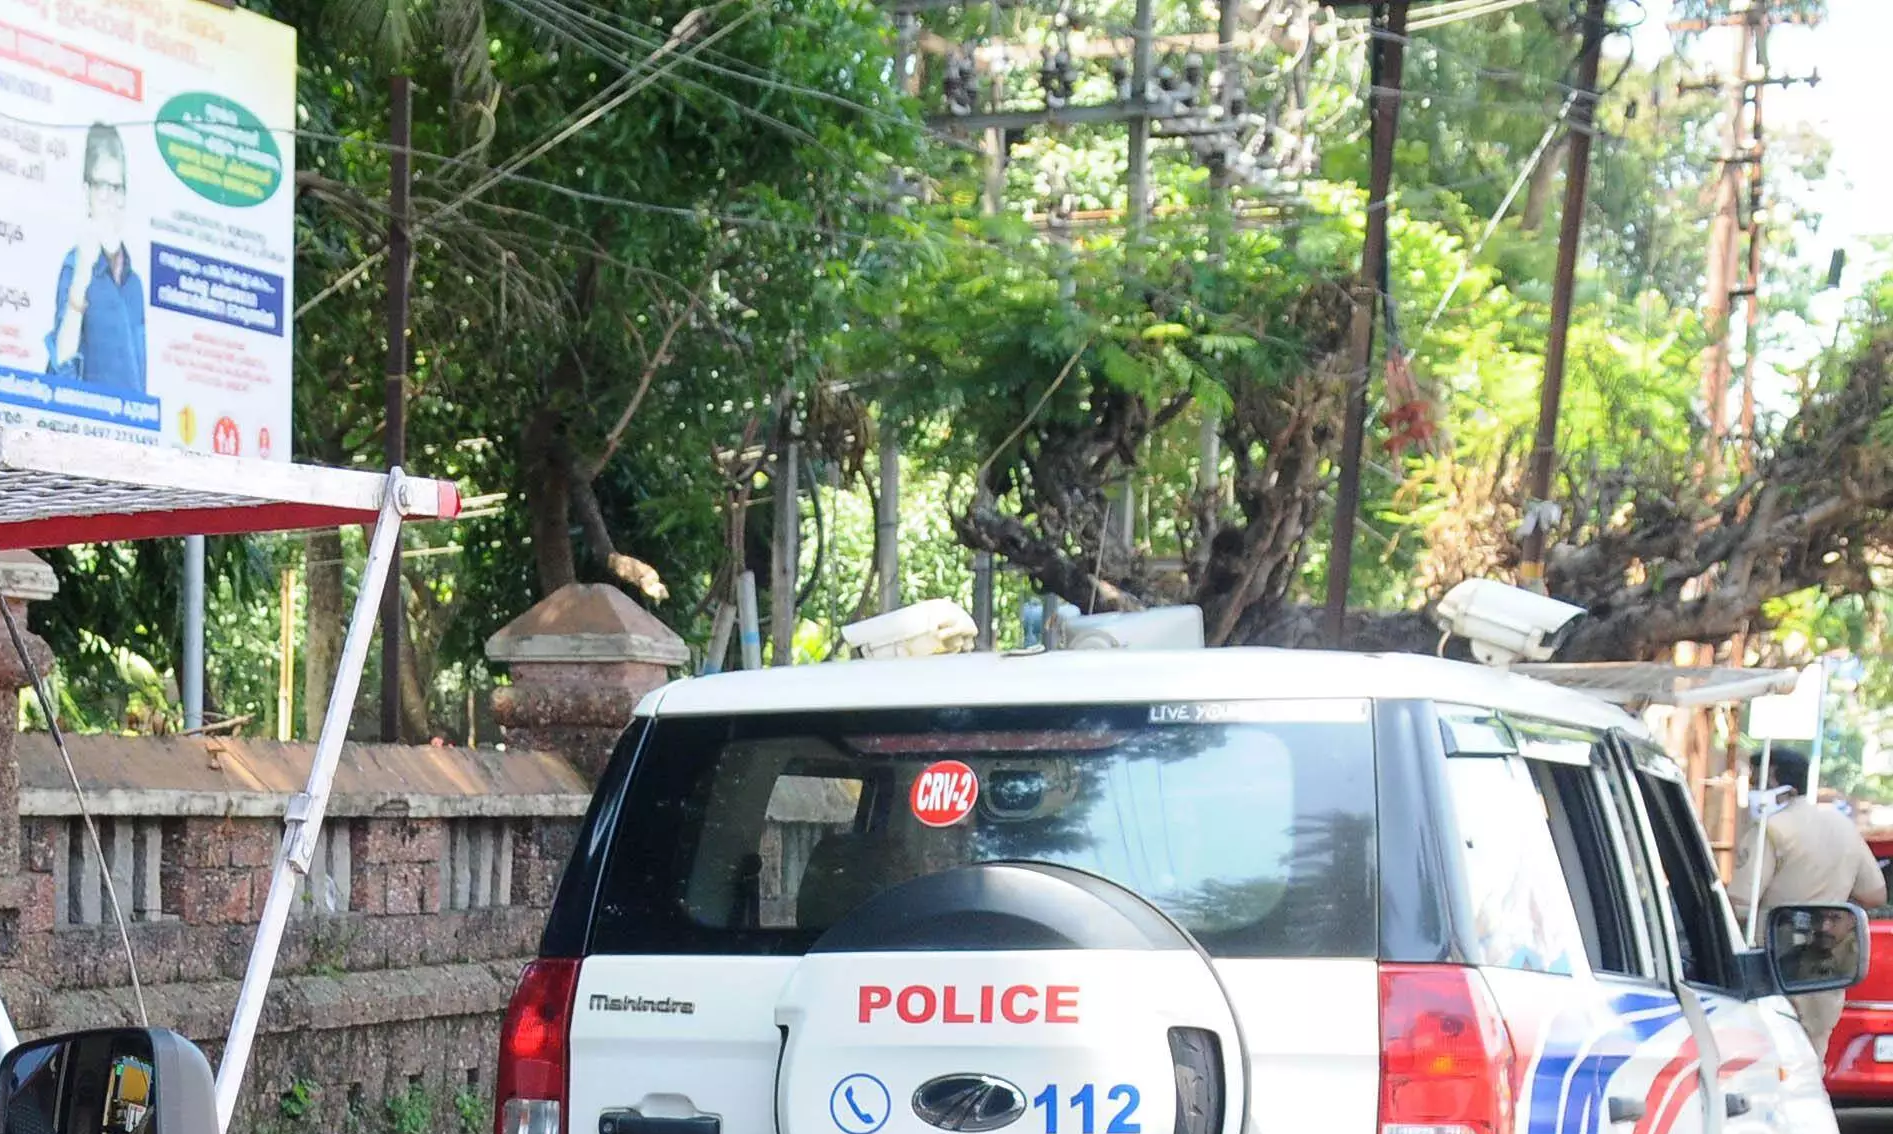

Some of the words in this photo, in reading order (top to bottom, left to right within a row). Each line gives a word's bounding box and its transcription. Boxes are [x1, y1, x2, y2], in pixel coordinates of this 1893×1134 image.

[916, 772, 973, 812] CRV-2
[589, 994, 695, 1014] Mahindra
[858, 984, 1080, 1024] POLICE
[1034, 1083, 1142, 1134] 112
